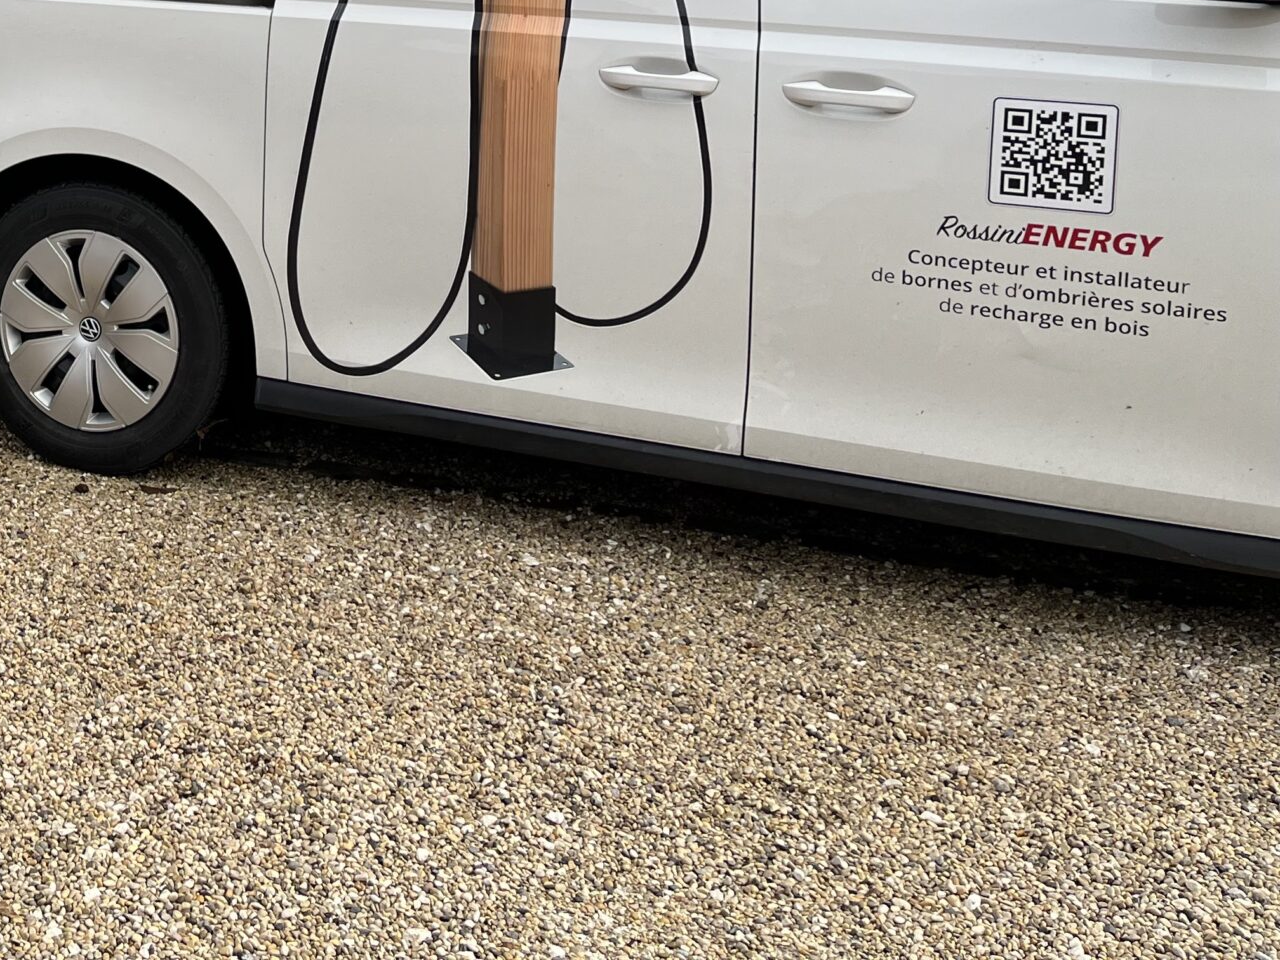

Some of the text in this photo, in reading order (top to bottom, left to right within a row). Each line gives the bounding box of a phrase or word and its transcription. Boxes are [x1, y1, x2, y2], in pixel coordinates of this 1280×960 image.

[908, 249, 1191, 294] Concepteur et installateur
[871, 267, 1228, 322] de bornes et d'ombrières solaires
[939, 298, 1149, 337] de recharge en bois
